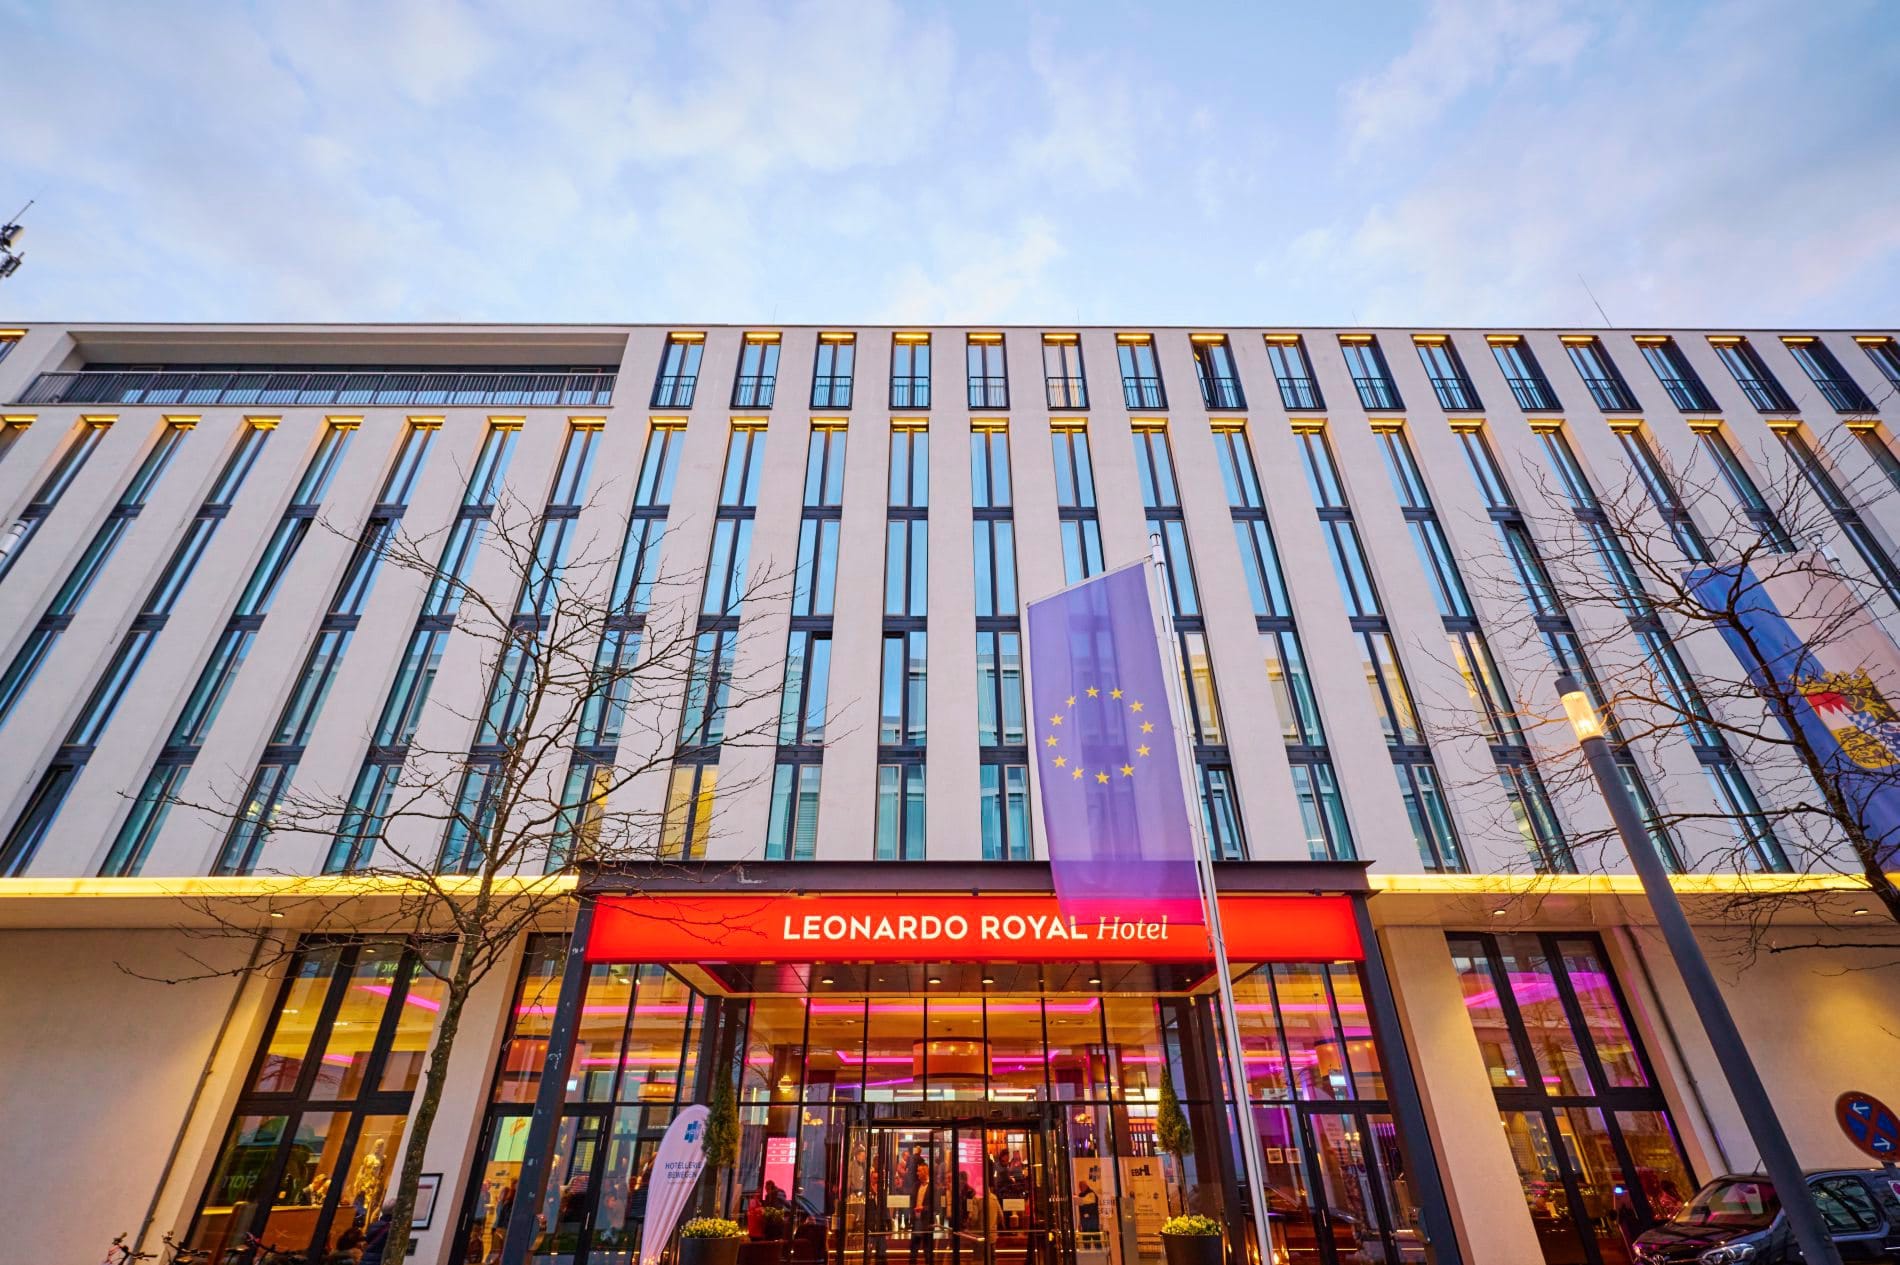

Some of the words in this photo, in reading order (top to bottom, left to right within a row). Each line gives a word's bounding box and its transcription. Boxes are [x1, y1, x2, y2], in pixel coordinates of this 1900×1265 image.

[783, 914, 969, 940] LEONARDO
[981, 914, 1088, 940] ROYAL
[1096, 914, 1169, 940] Hotel
